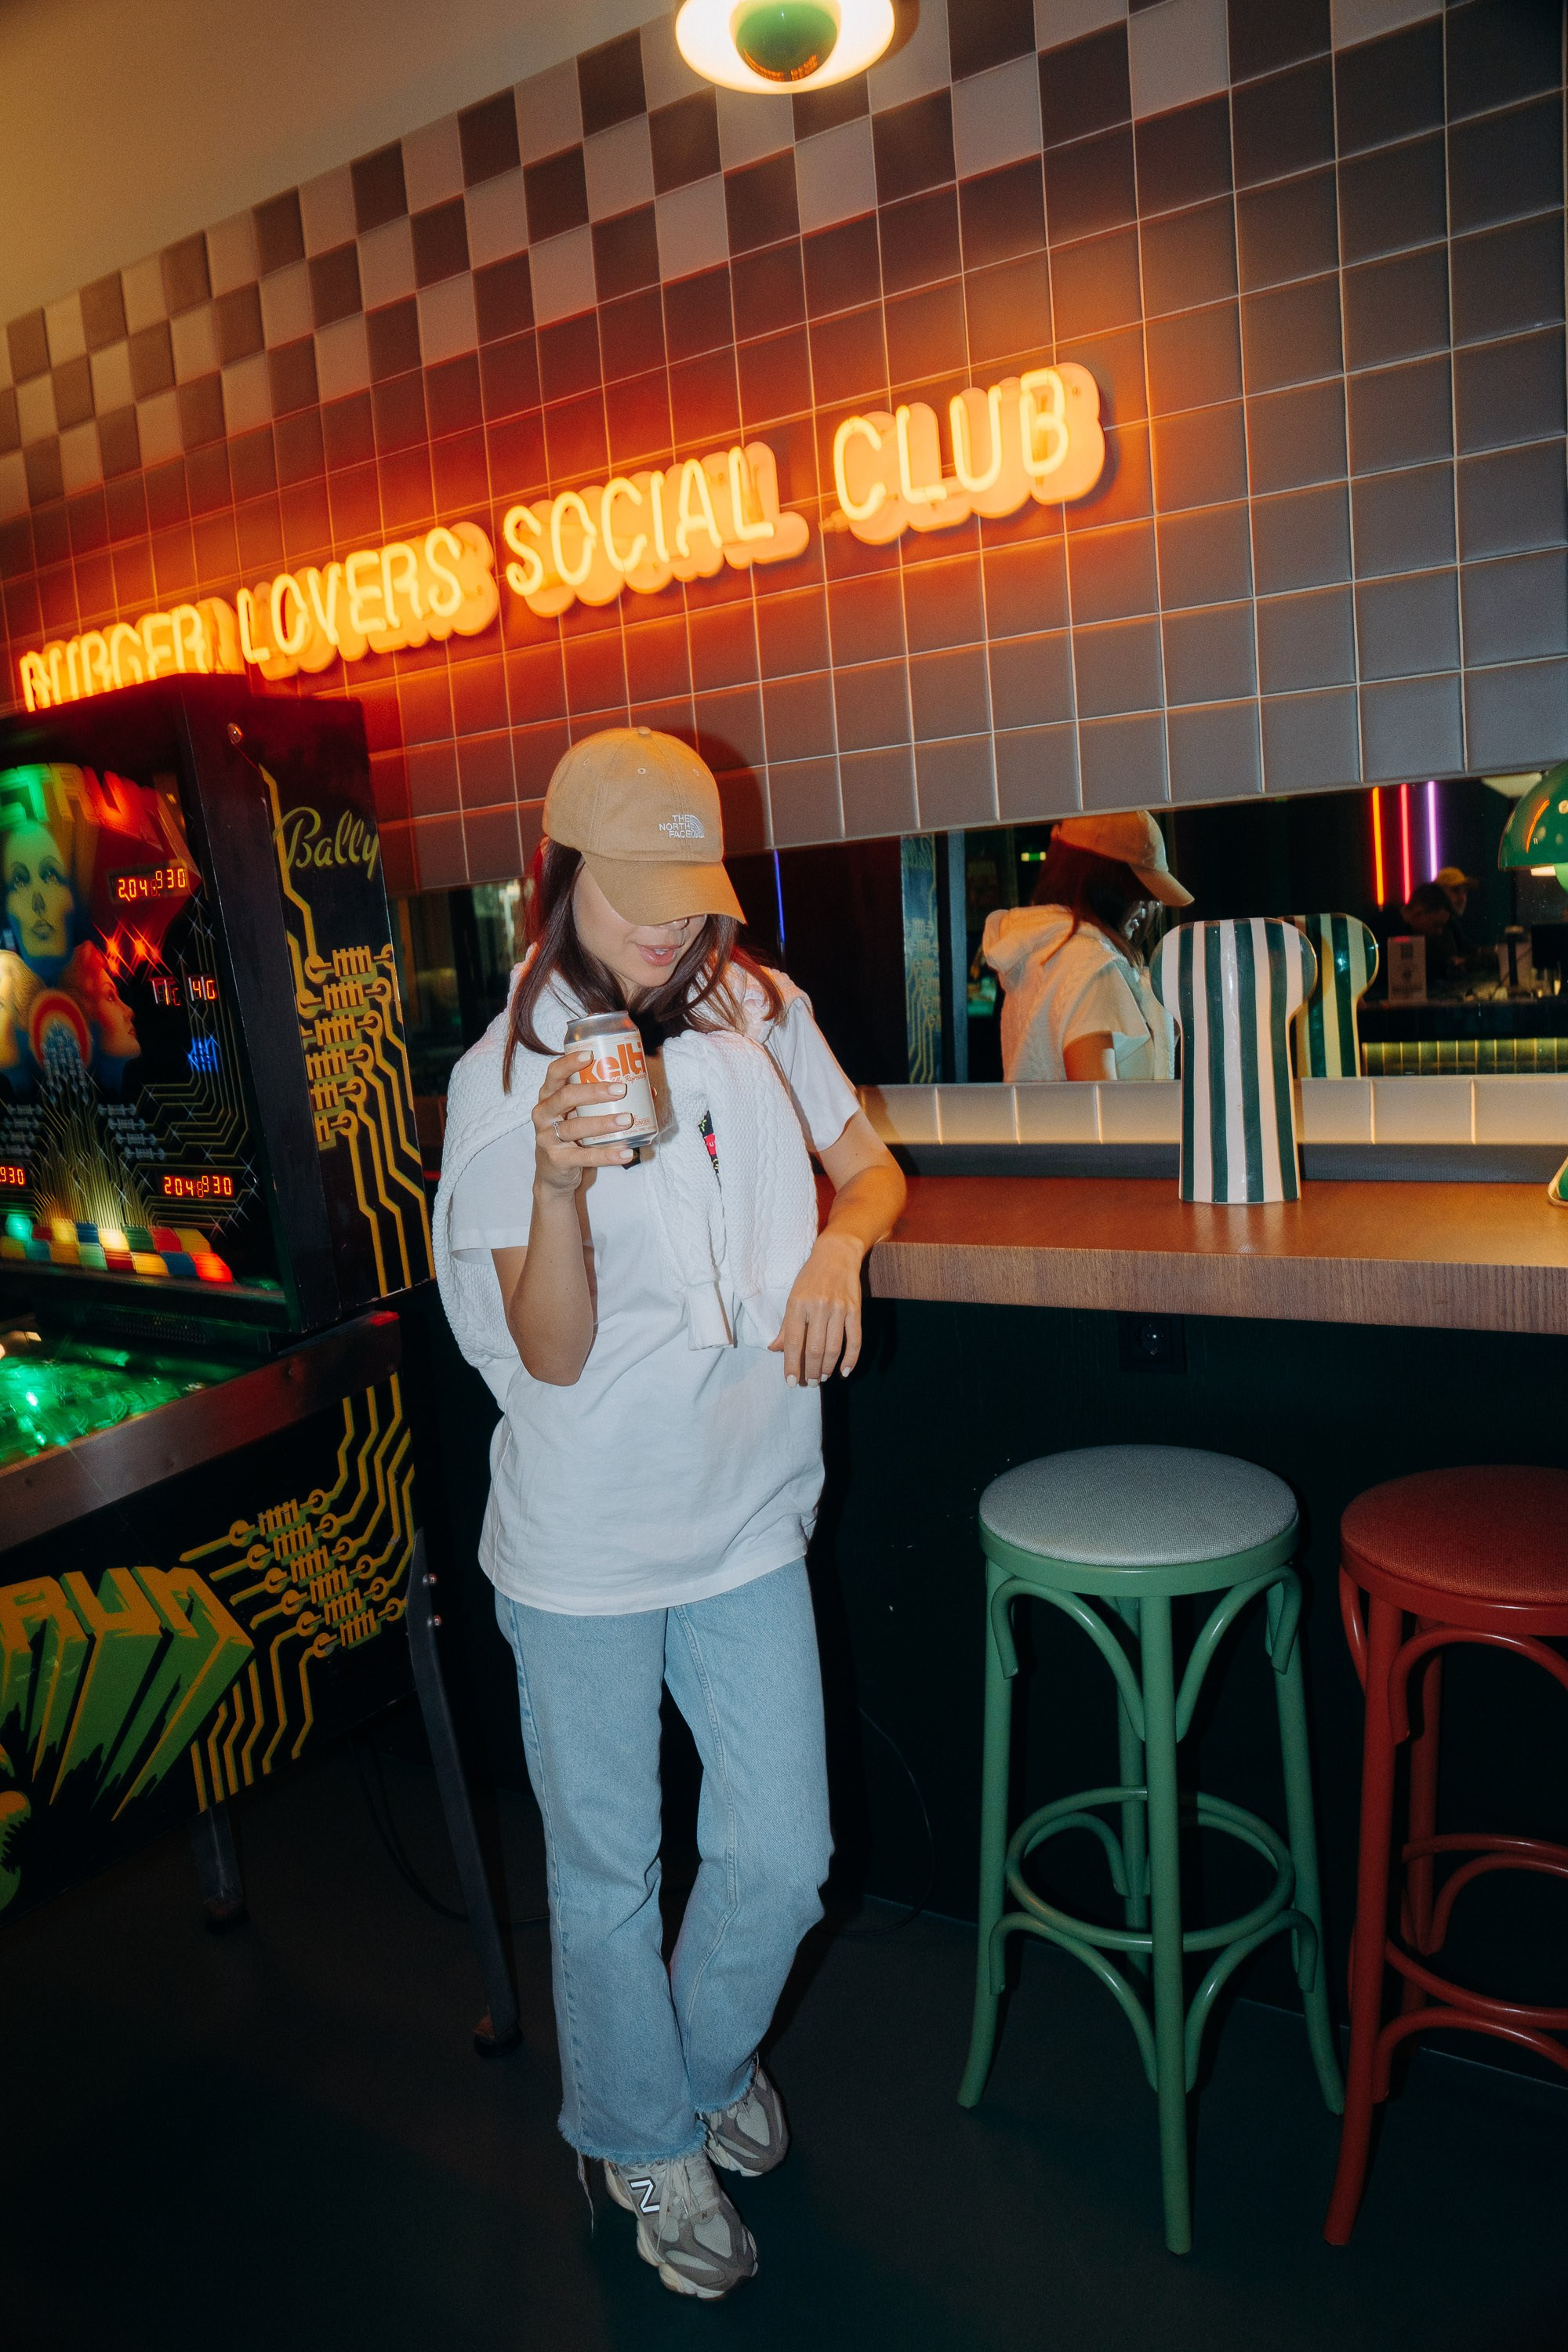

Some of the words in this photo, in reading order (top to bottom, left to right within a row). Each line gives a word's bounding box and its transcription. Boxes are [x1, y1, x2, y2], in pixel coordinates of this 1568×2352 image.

[20, 603, 210, 712] BURGER
[236, 526, 463, 665] LOVERS
[503, 445, 775, 597] SOCIAL
[833, 368, 1069, 521] CLUB
[672, 814, 691, 822] THE
[659, 822, 691, 831] NORTH
[669, 829, 691, 838] FACE
[273, 806, 379, 879] Bally
